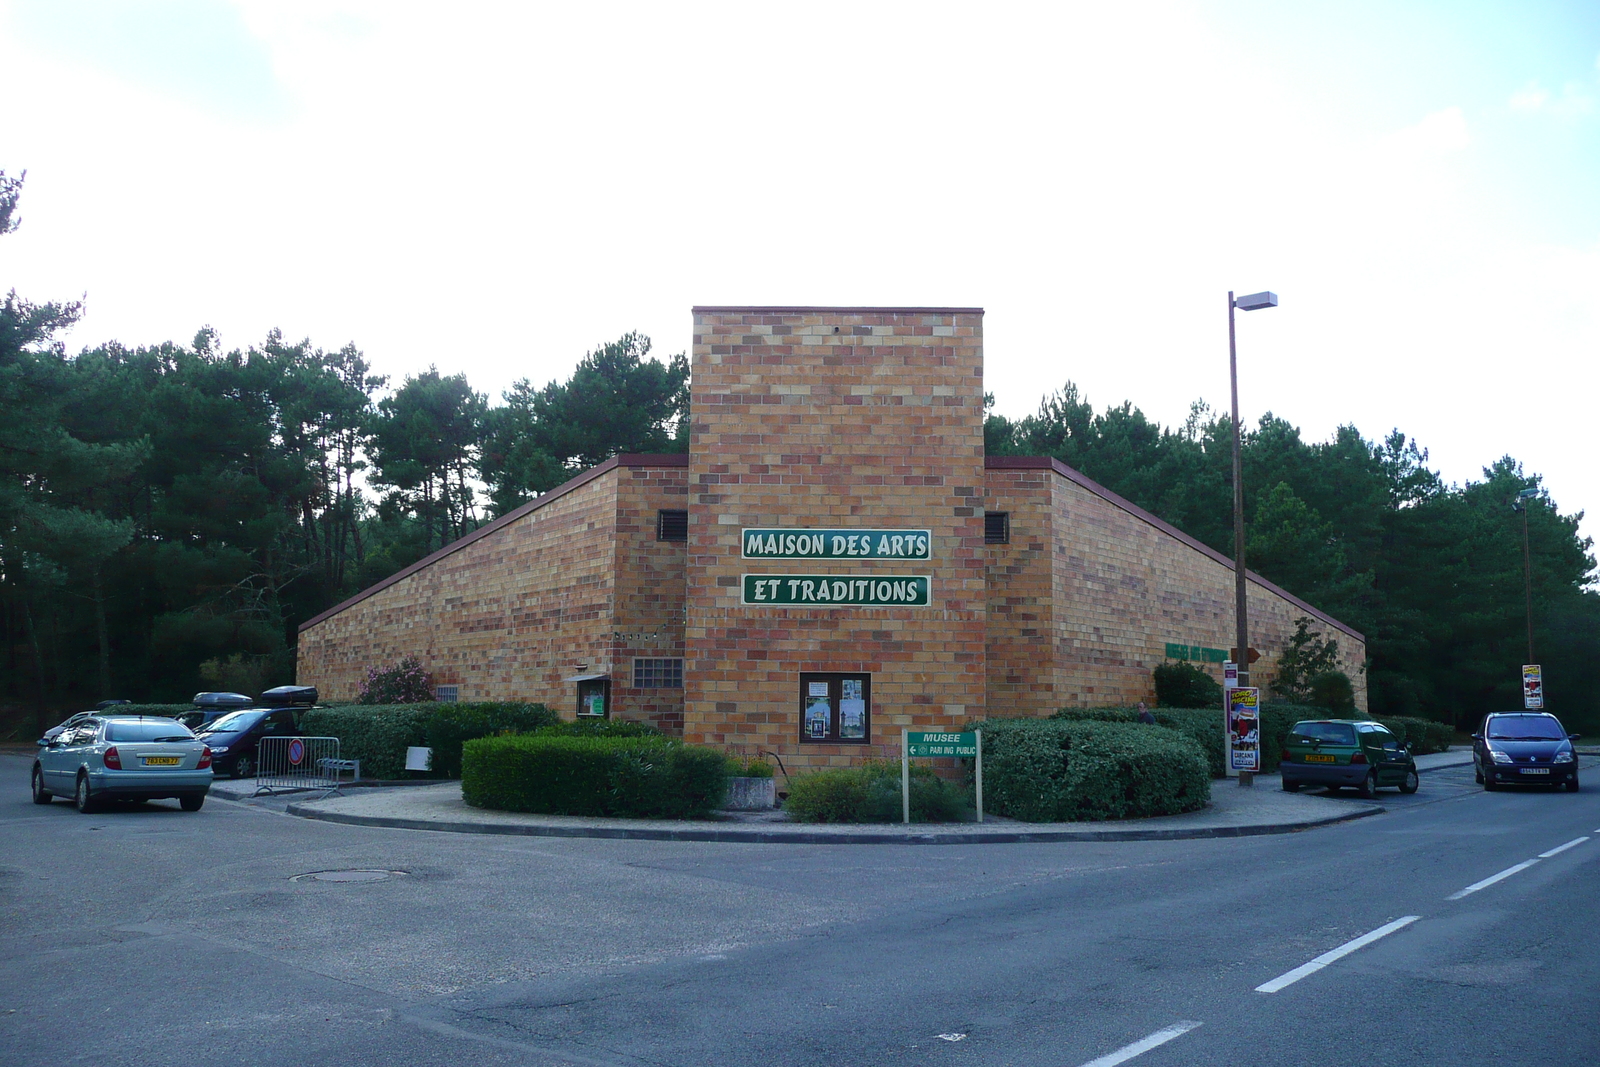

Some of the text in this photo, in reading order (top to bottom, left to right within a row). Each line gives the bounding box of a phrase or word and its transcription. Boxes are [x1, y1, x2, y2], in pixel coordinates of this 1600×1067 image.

[746, 533, 927, 556] MAISON DES ARTS
[754, 579, 918, 602] ET TRADITIONS
[1231, 690, 1252, 699] TORO
[923, 733, 961, 742] MUSEE
[956, 746, 976, 755] PUBLIC
